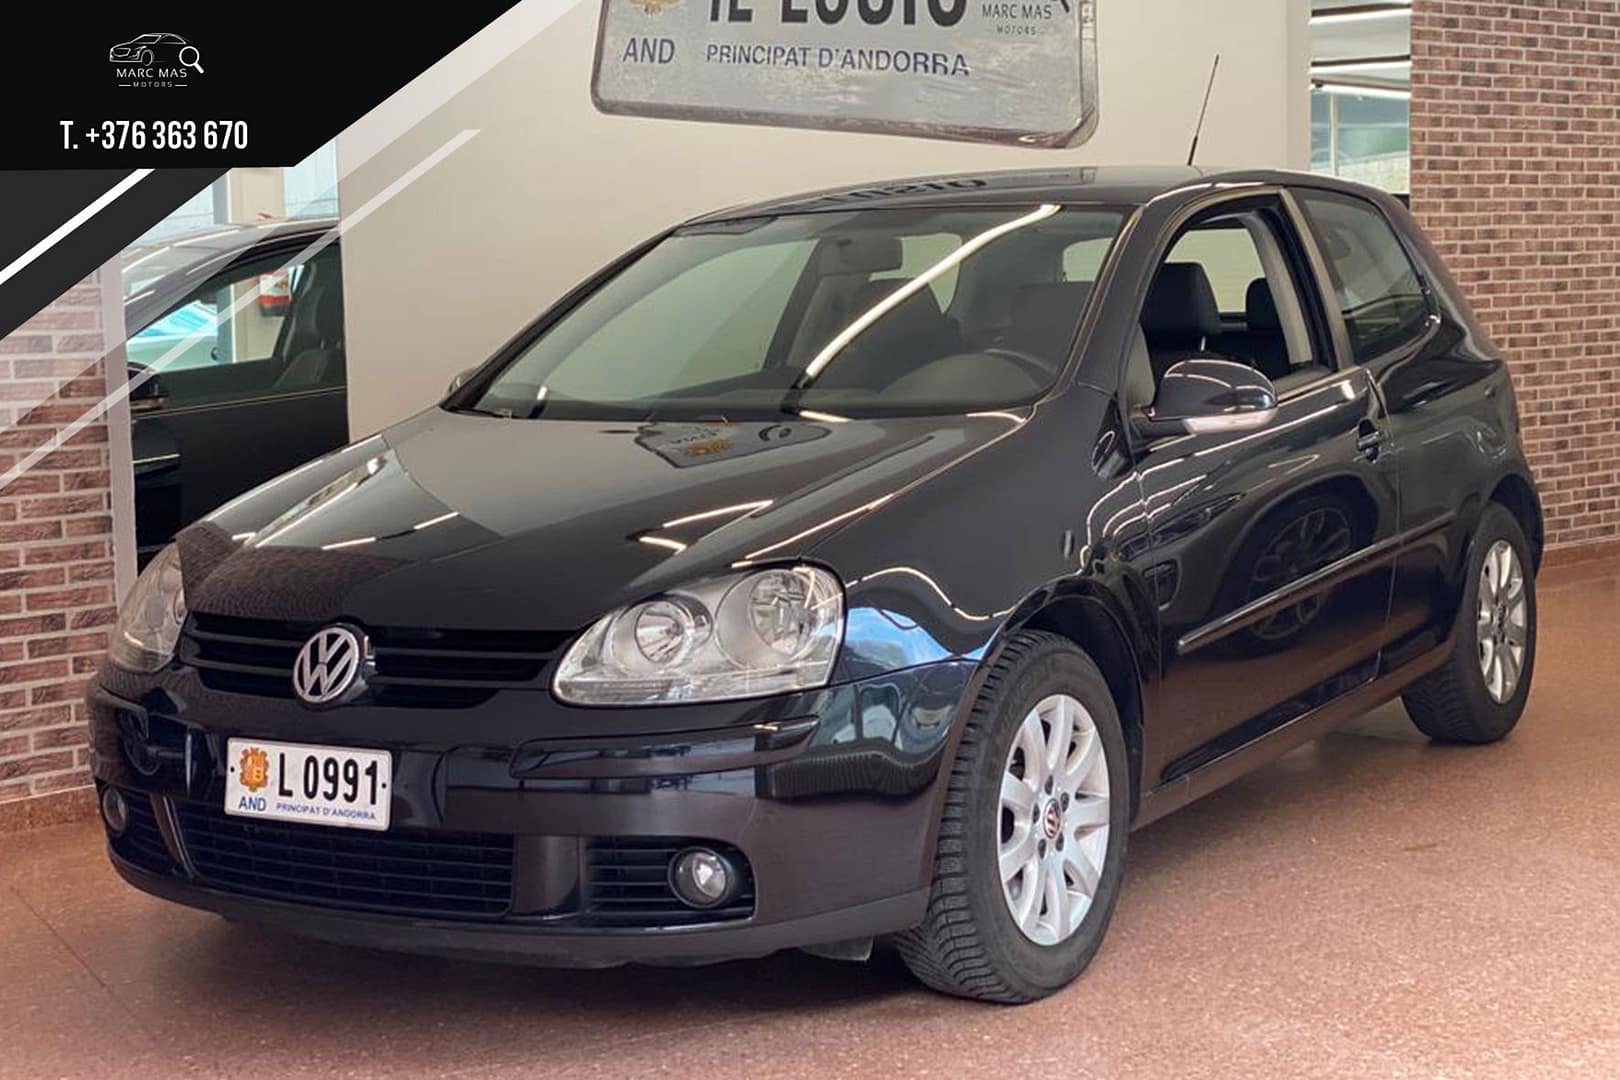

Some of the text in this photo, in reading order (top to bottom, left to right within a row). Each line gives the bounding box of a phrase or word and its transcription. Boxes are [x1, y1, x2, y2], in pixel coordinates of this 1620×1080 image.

[981, 3, 1018, 19] MARC
[1021, 4, 1053, 20] MAS
[622, 37, 676, 64] AND
[705, 44, 970, 76] PRINCIPAT D'ANDORRA
[278, 752, 378, 805] L 0991
[238, 796, 267, 812] AND
[275, 802, 321, 817] PRINCIPAT
